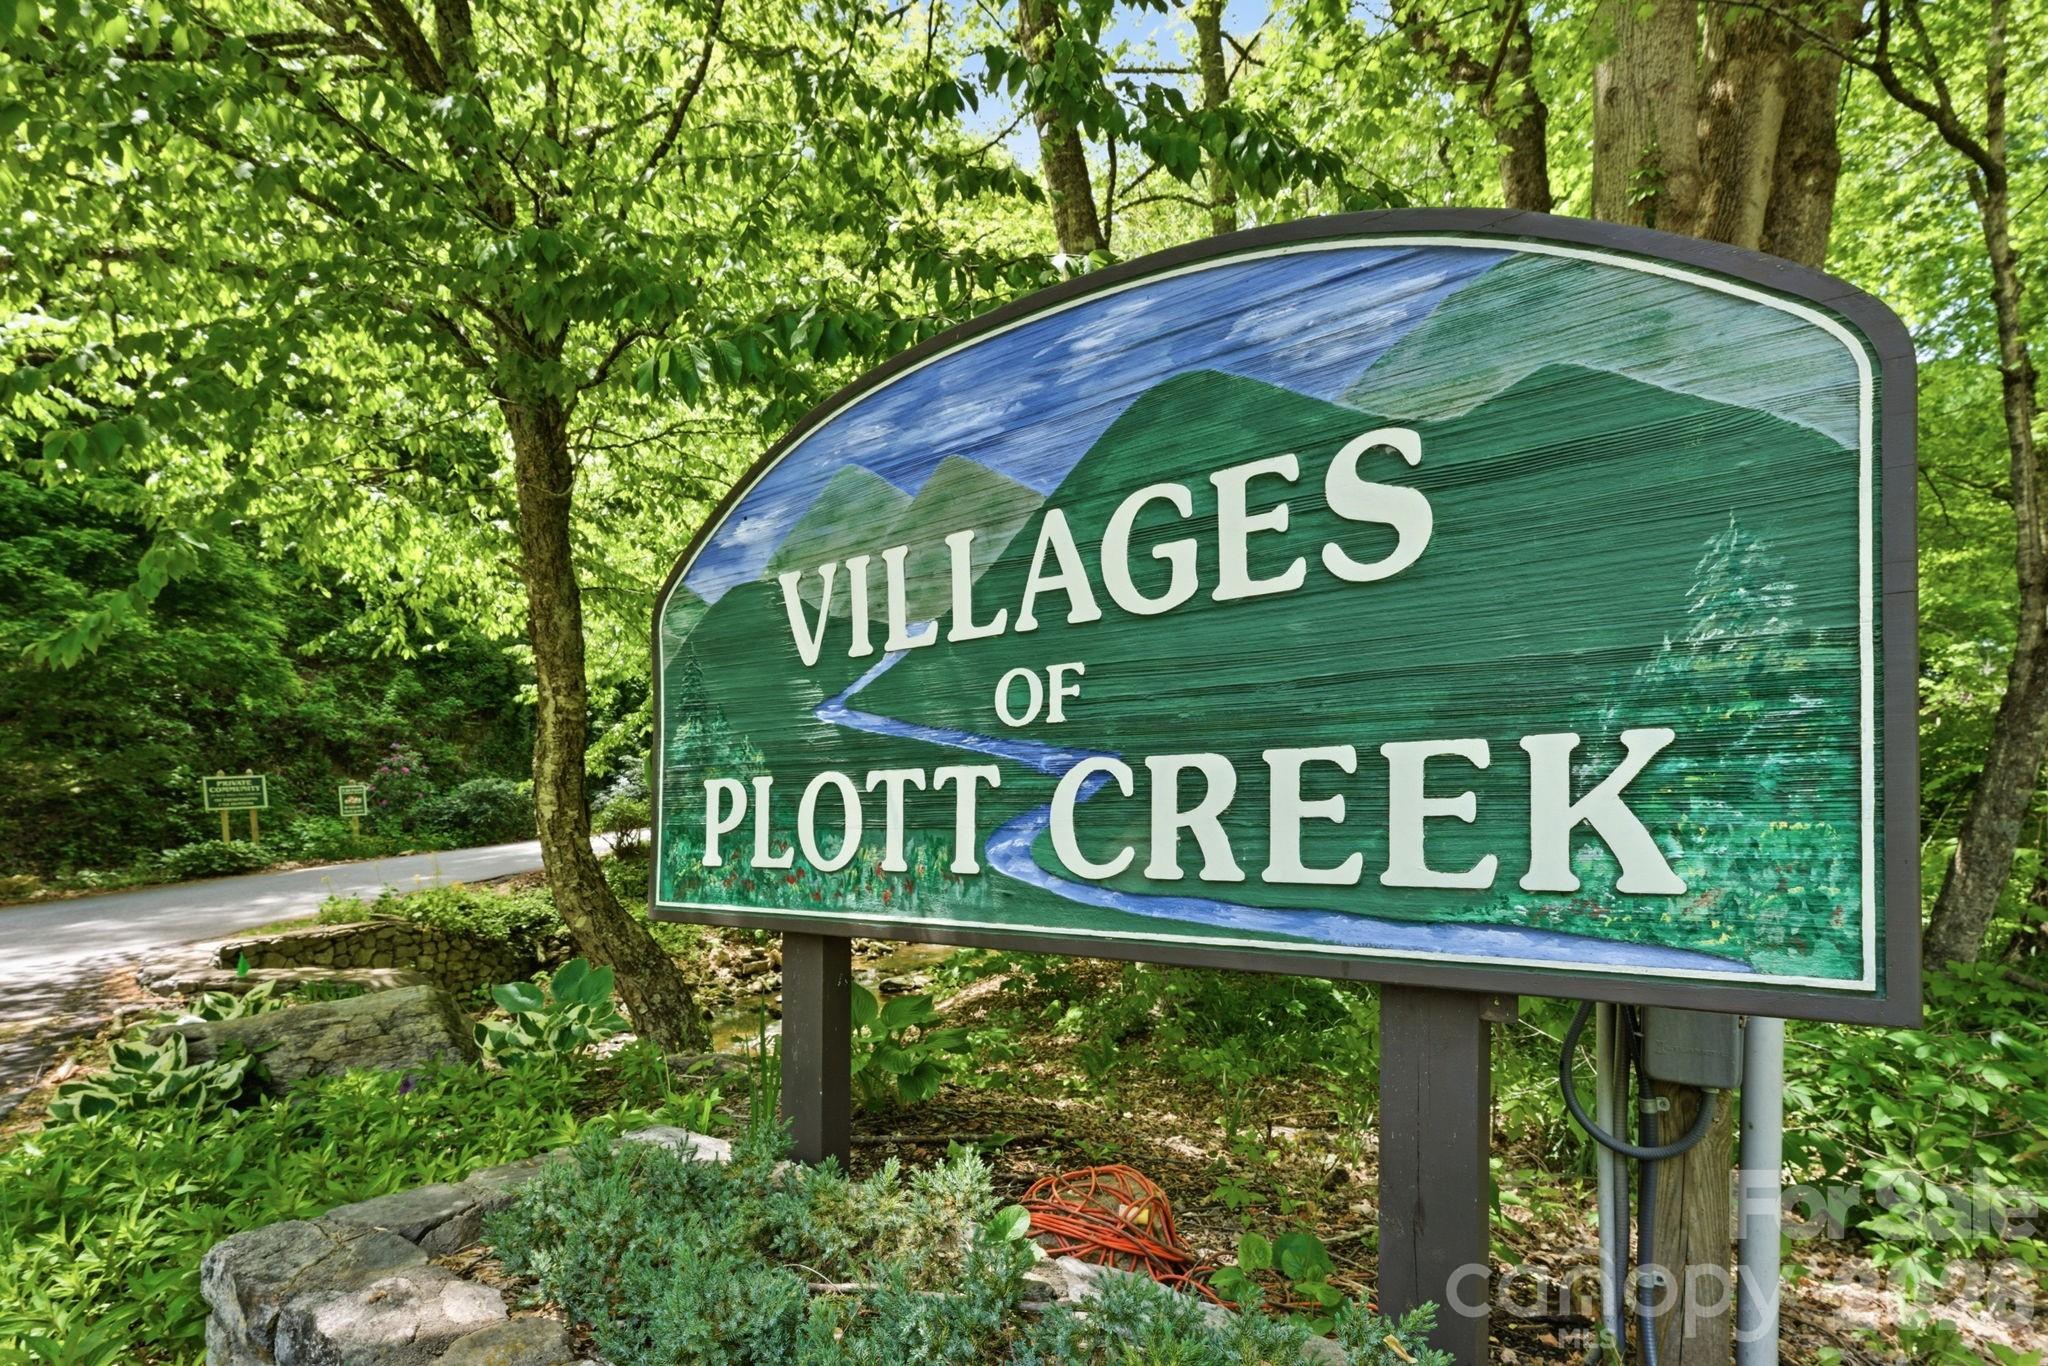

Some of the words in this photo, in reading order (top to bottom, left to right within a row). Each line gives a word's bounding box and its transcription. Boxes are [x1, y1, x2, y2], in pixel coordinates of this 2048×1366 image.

[778, 426, 1434, 667] VILLAGES
[994, 661, 1086, 728] OF
[208, 785, 261, 793] COMMUNITY
[702, 763, 1001, 876] PLOTT
[1049, 727, 1687, 895] CREEK
